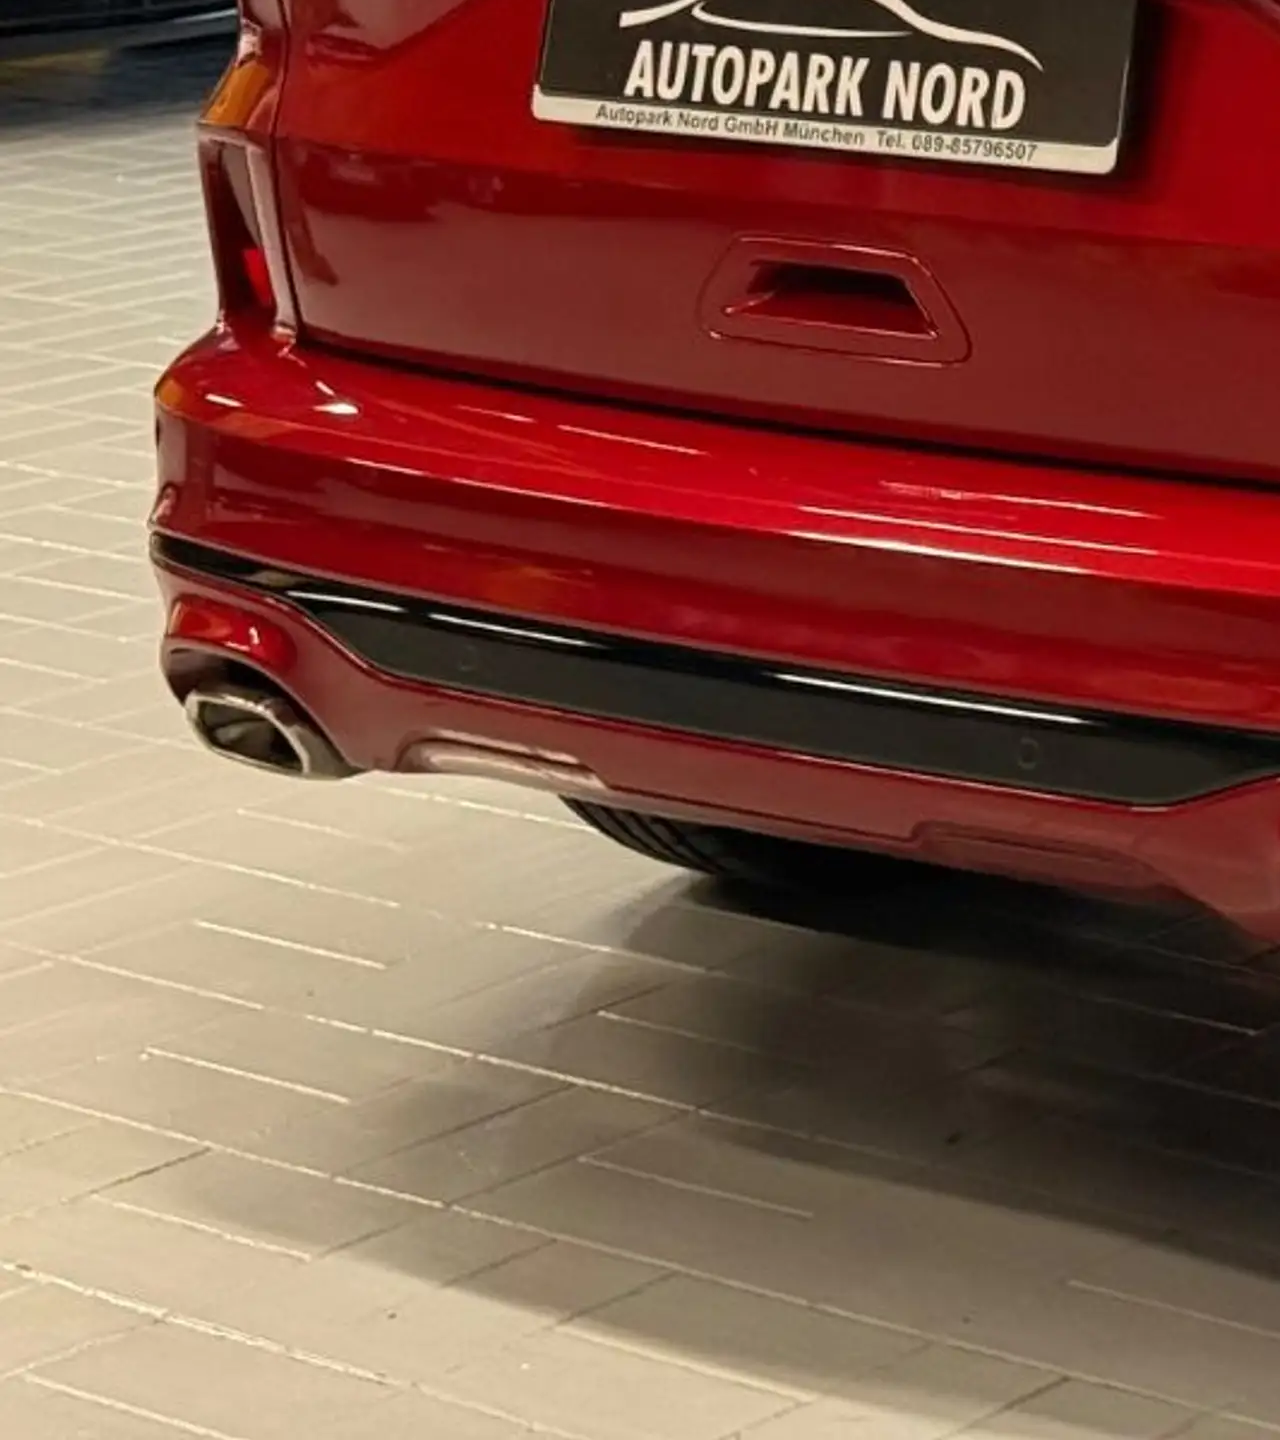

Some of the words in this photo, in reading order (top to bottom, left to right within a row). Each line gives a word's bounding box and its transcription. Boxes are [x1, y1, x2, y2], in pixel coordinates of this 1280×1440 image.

[623, 39, 870, 116] AUTOPARK
[882, 59, 1026, 130] NORD
[596, 104, 675, 128] Autopark
[677, 109, 719, 131] Nord
[724, 115, 778, 137] GmbH
[782, 120, 865, 144] München
[877, 130, 905, 150] Tel.
[912, 134, 1038, 161] 089-85796507
